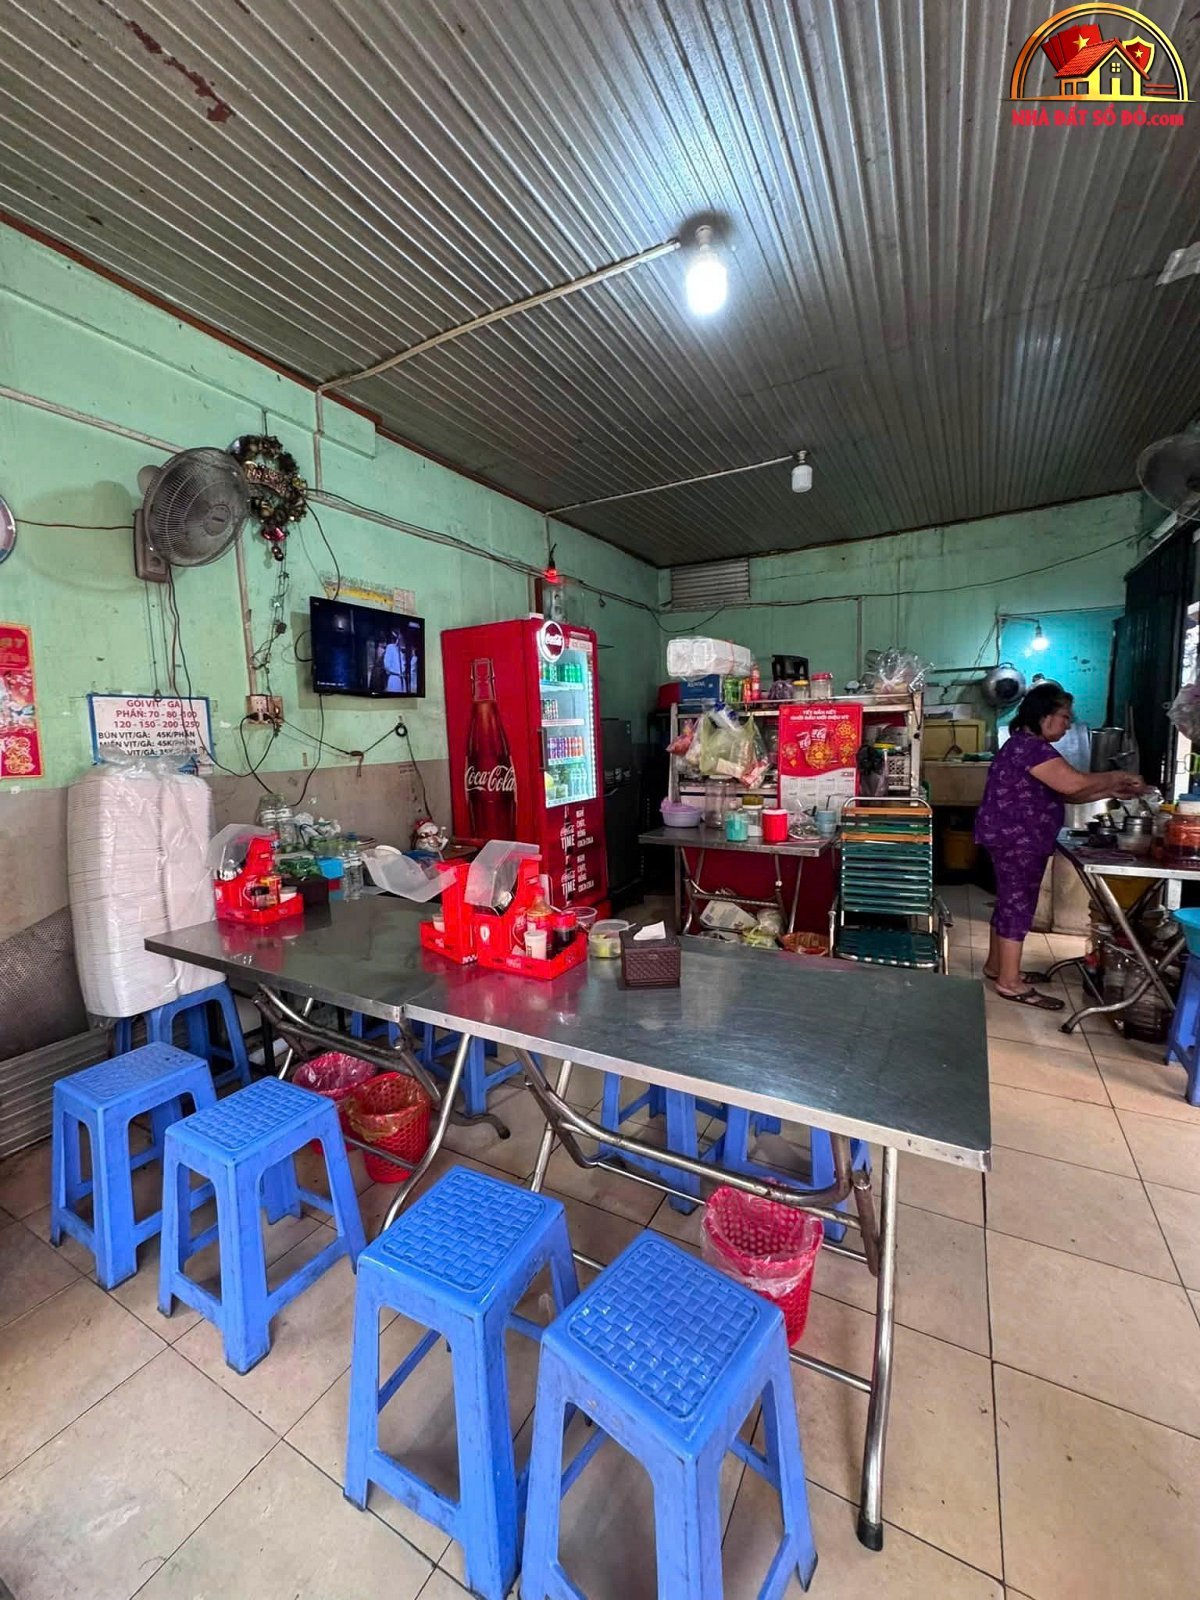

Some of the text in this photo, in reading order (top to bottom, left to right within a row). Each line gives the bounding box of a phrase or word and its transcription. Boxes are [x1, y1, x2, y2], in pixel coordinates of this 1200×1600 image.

[148, 710, 160, 718] 70
[166, 710, 178, 718] 80
[113, 720, 132, 728] 120
[139, 720, 156, 728] 150
[162, 720, 179, 728] 200
[185, 720, 201, 728] 250
[465, 764, 515, 792] Coca-Cola
